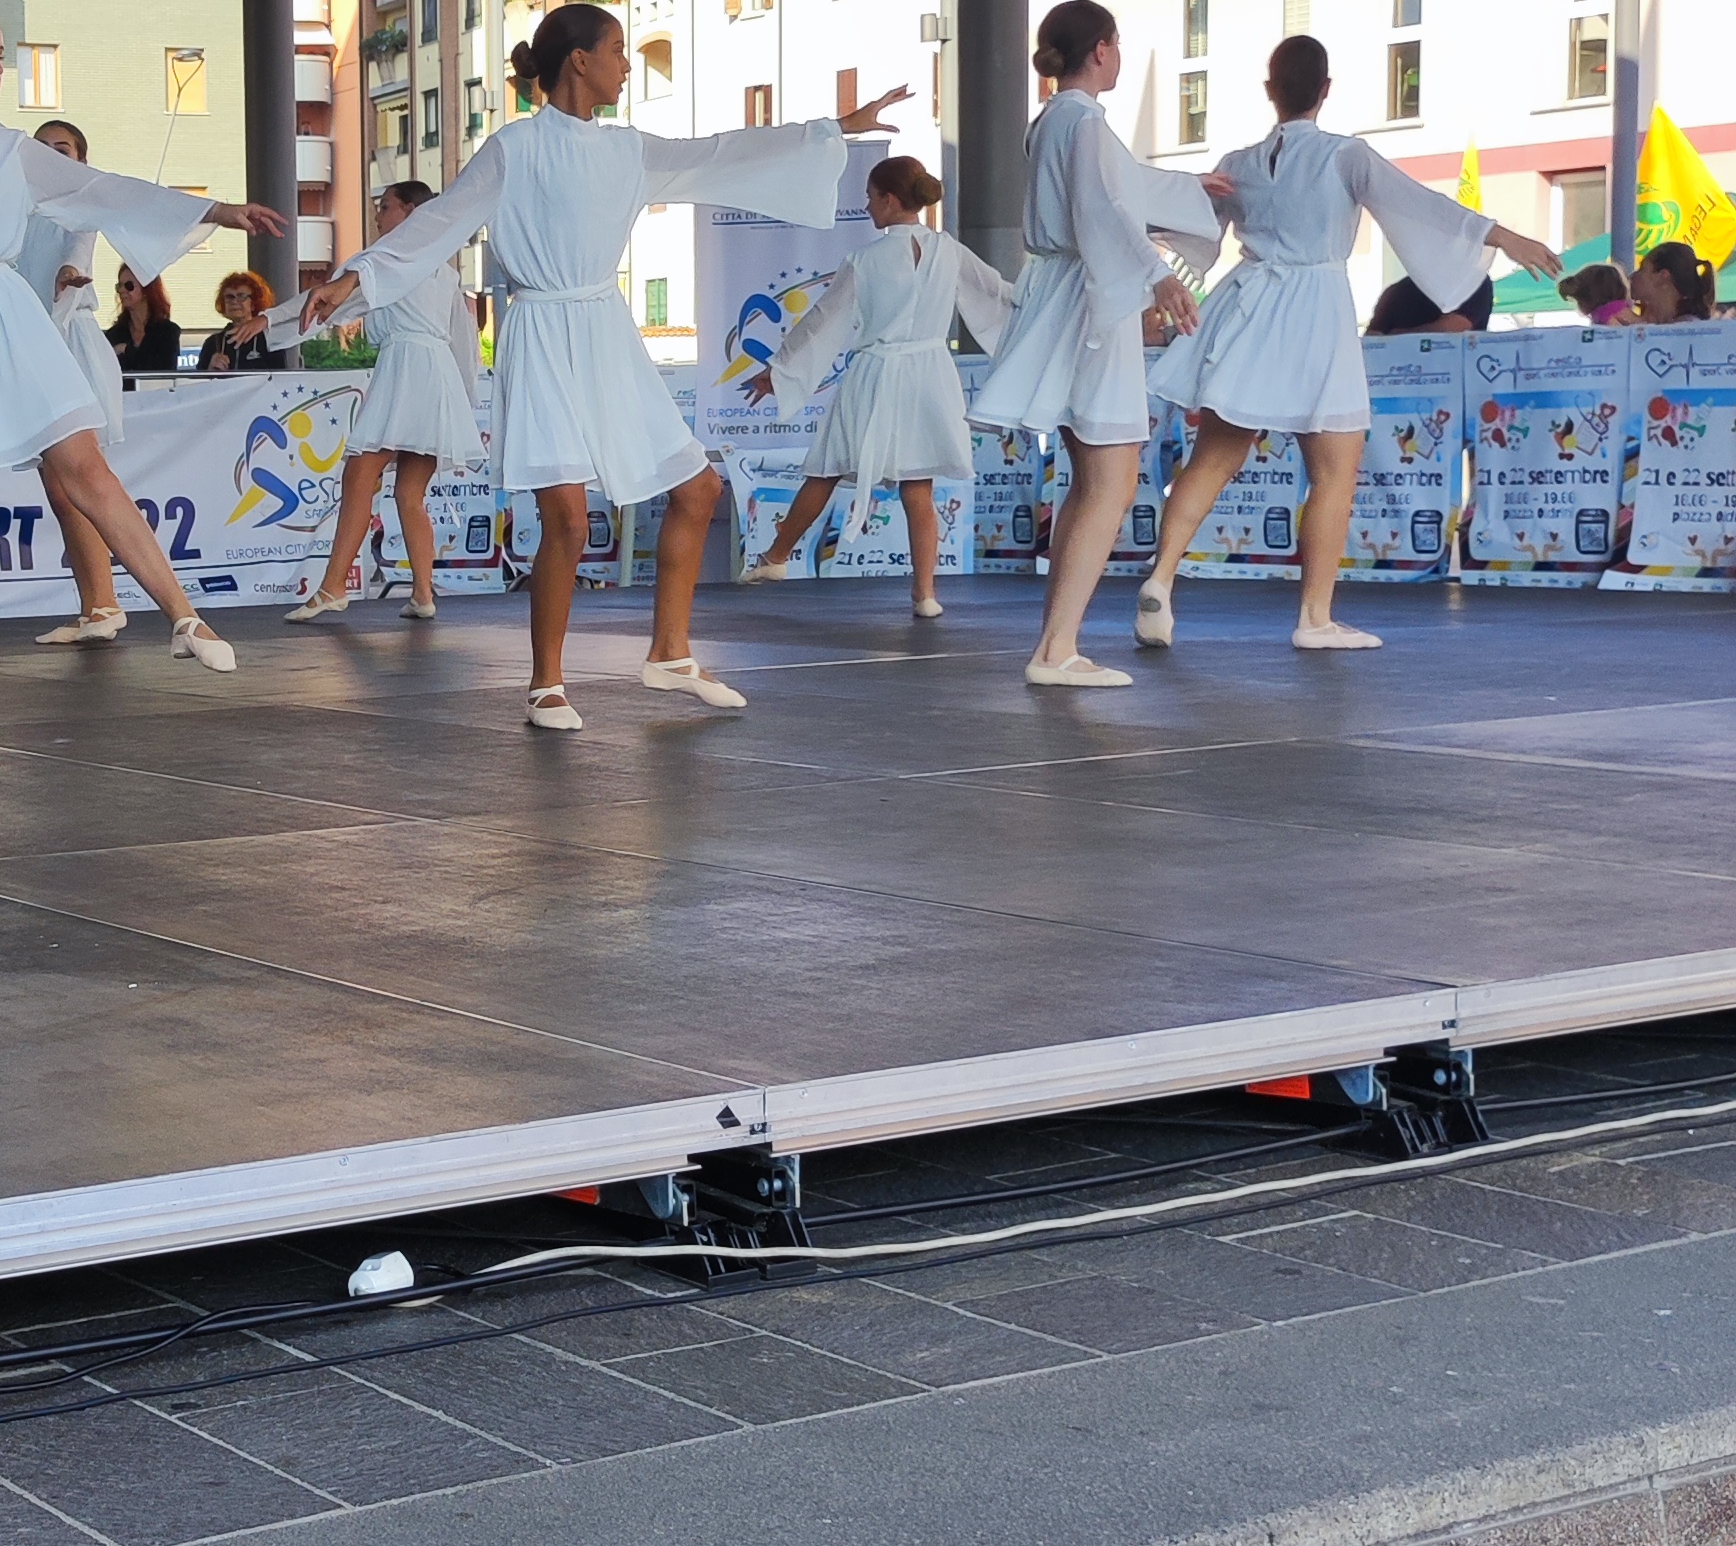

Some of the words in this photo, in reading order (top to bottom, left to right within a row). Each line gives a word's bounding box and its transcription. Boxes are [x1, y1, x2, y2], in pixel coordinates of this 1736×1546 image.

[707, 407, 761, 418] EUROPEAN
[763, 406, 778, 417] CIT
[804, 405, 826, 416] SPO
[708, 423, 750, 435] Vivere
[751, 424, 761, 434] a
[764, 420, 802, 435] ritmo
[804, 421, 818, 433] di
[1528, 466, 1610, 486] settembre
[1641, 467, 1661, 487] 21
[1666, 471, 1677, 487] e
[1681, 467, 1701, 487] 22
[225, 545, 283, 561] EUROPEAN
[285, 543, 307, 556] CITY
